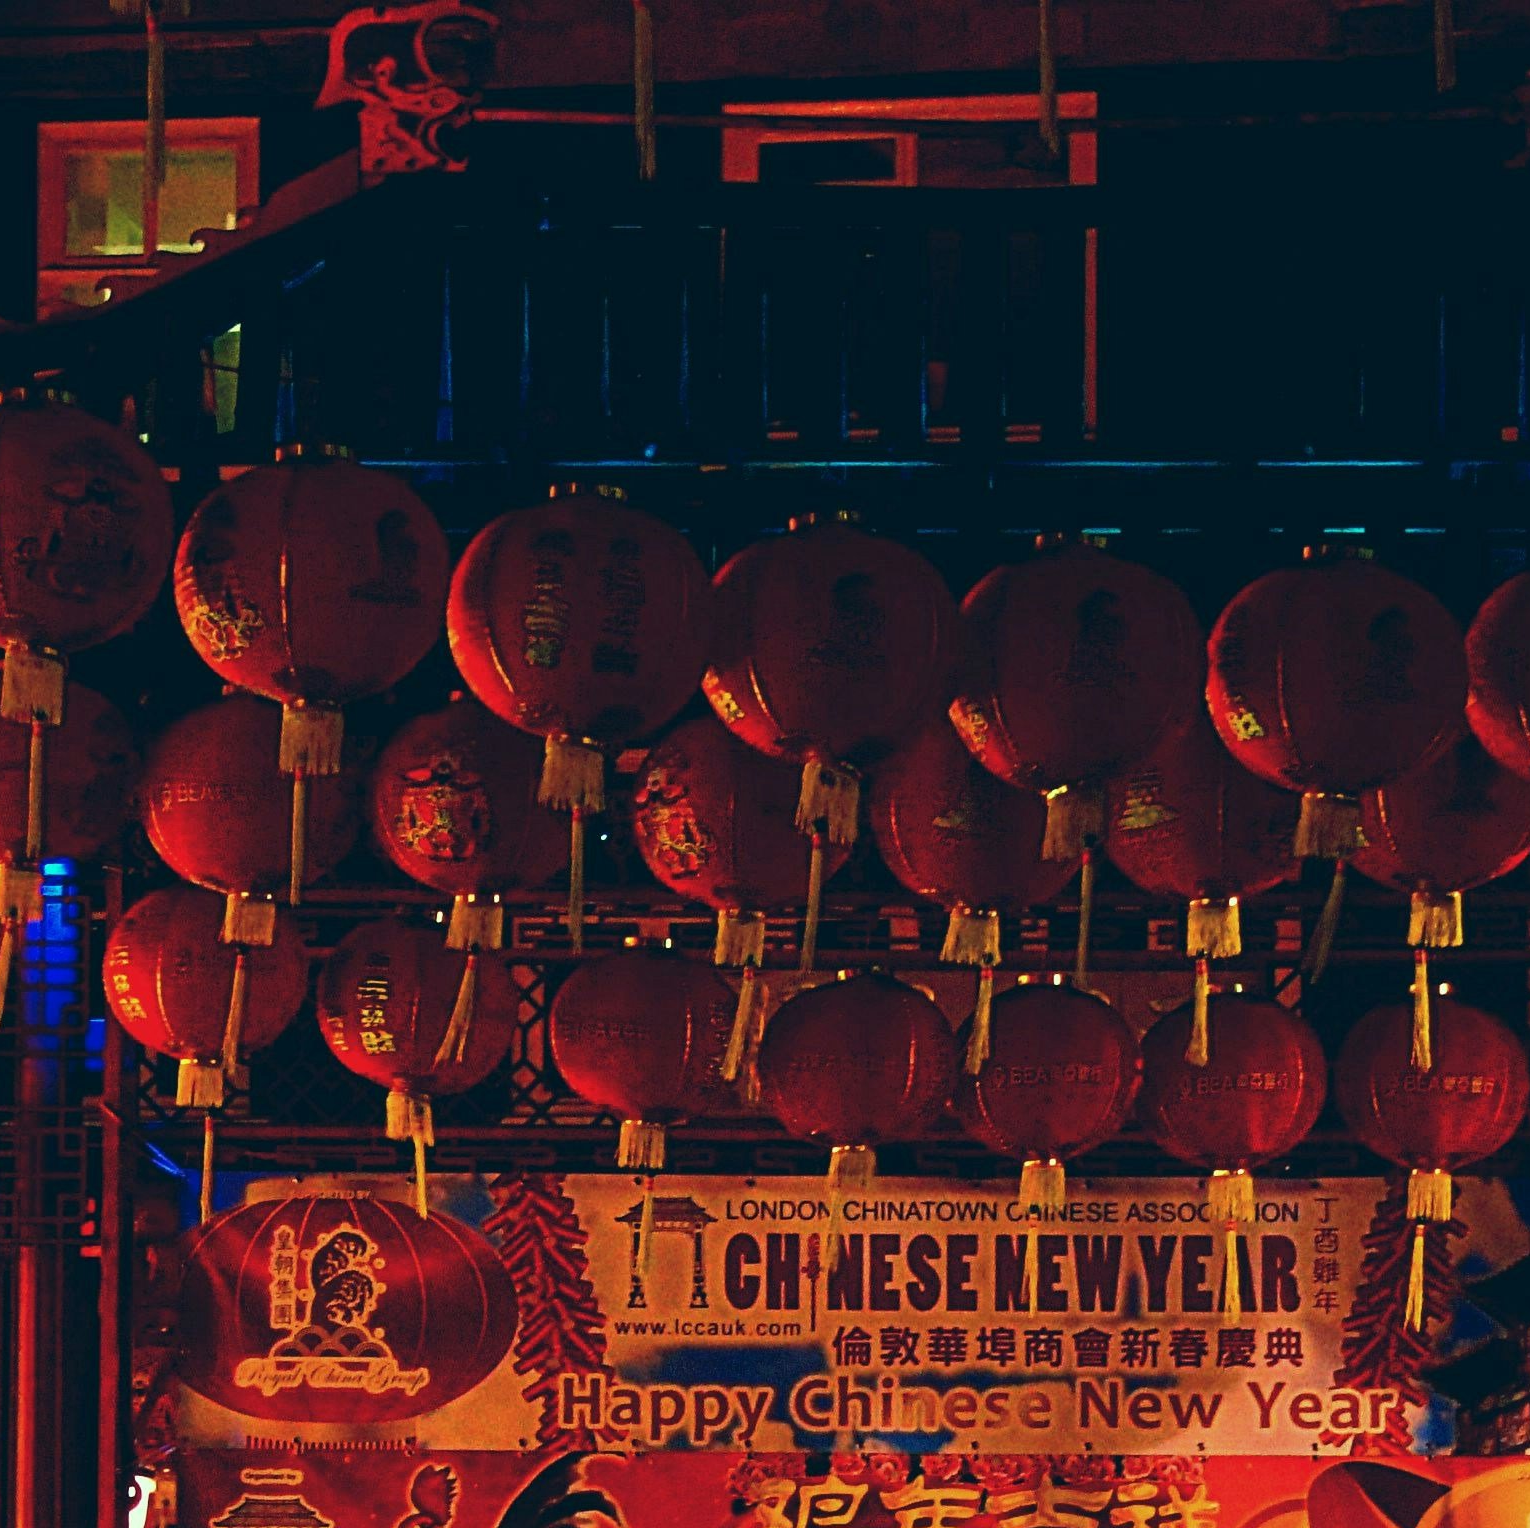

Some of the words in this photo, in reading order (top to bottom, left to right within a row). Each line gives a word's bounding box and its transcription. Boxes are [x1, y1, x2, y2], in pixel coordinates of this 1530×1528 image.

[726, 1200, 830, 1221] LONDON
[842, 1200, 998, 1222] CHINATOWN
[1125, 1201, 1299, 1223] ASSOCION
[724, 1232, 979, 1312] CHINESE
[995, 1234, 1124, 1313] NEW
[1138, 1234, 1302, 1313] YEAR
[615, 1319, 802, 1337] www.lccauk.com
[564, 1374, 772, 1443] Happy
[791, 1373, 1053, 1431] Chinese
[1079, 1380, 1223, 1430] New
[1247, 1380, 1396, 1431] Year
